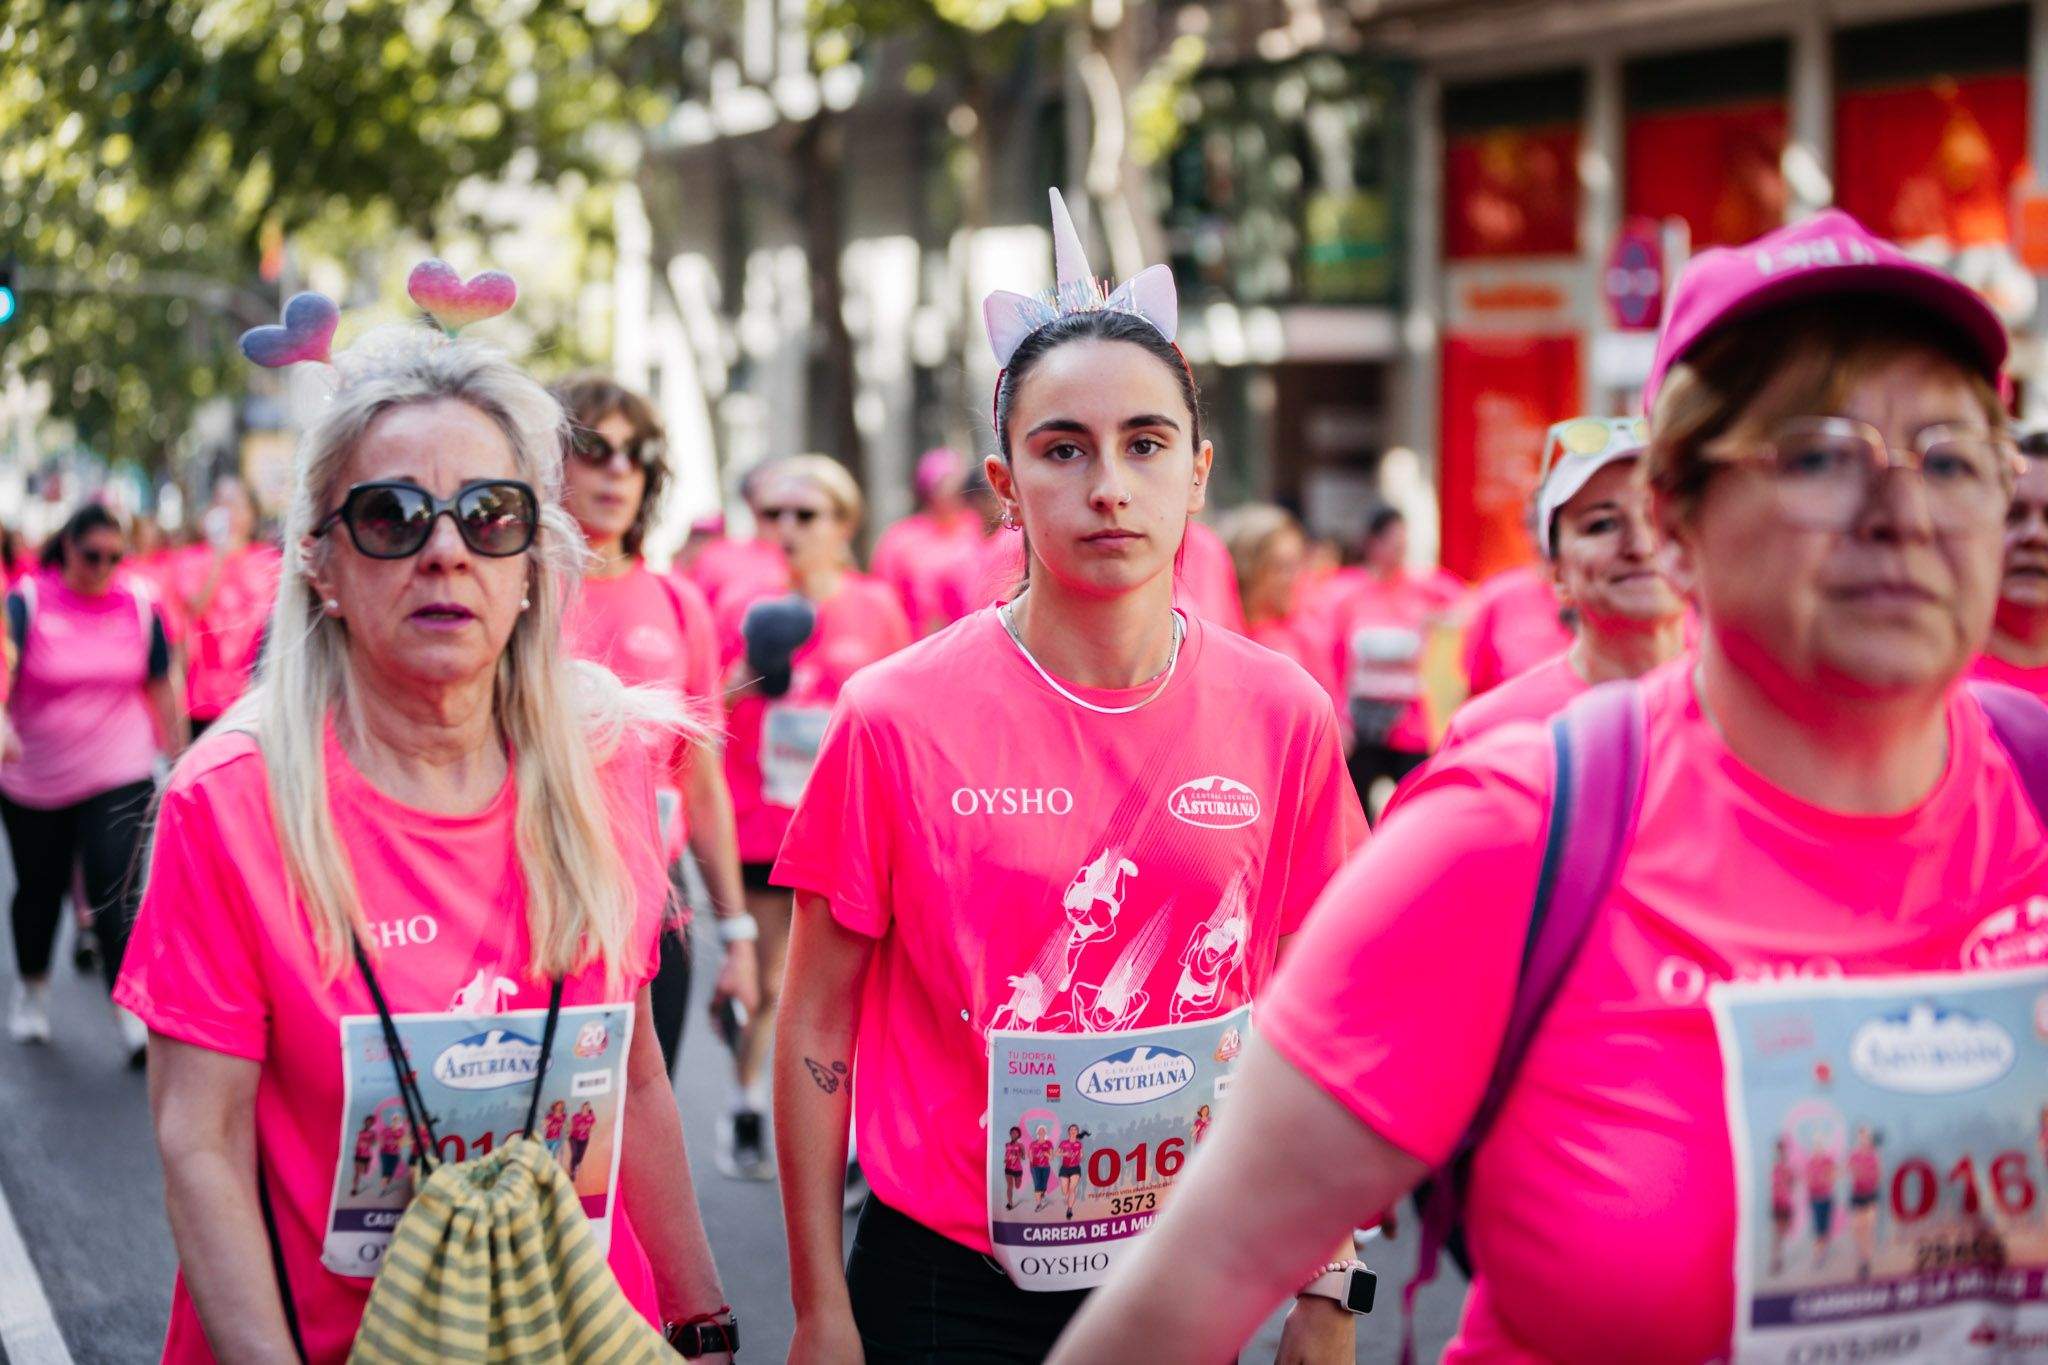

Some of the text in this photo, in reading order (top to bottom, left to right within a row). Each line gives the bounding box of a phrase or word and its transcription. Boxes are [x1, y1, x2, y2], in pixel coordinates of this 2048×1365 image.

[951, 787, 1073, 816] OYSHO
[1177, 793, 1255, 817] ASTURIANA
[1008, 1050, 1056, 1060] TU DORSAL
[1008, 1061, 1056, 1075] SUMA
[1086, 1068, 1187, 1094] ASTURIANA
[437, 1129, 525, 1163] 01
[1088, 1137, 1185, 1188] 016
[1890, 1150, 2036, 1223] 016
[1110, 1192, 1156, 1215] 3573
[1023, 1225, 1087, 1242] CARRERA
[1091, 1224, 1108, 1238] DE
[1112, 1220, 1127, 1235] LA
[1020, 1252, 1109, 1276] OYSHO
